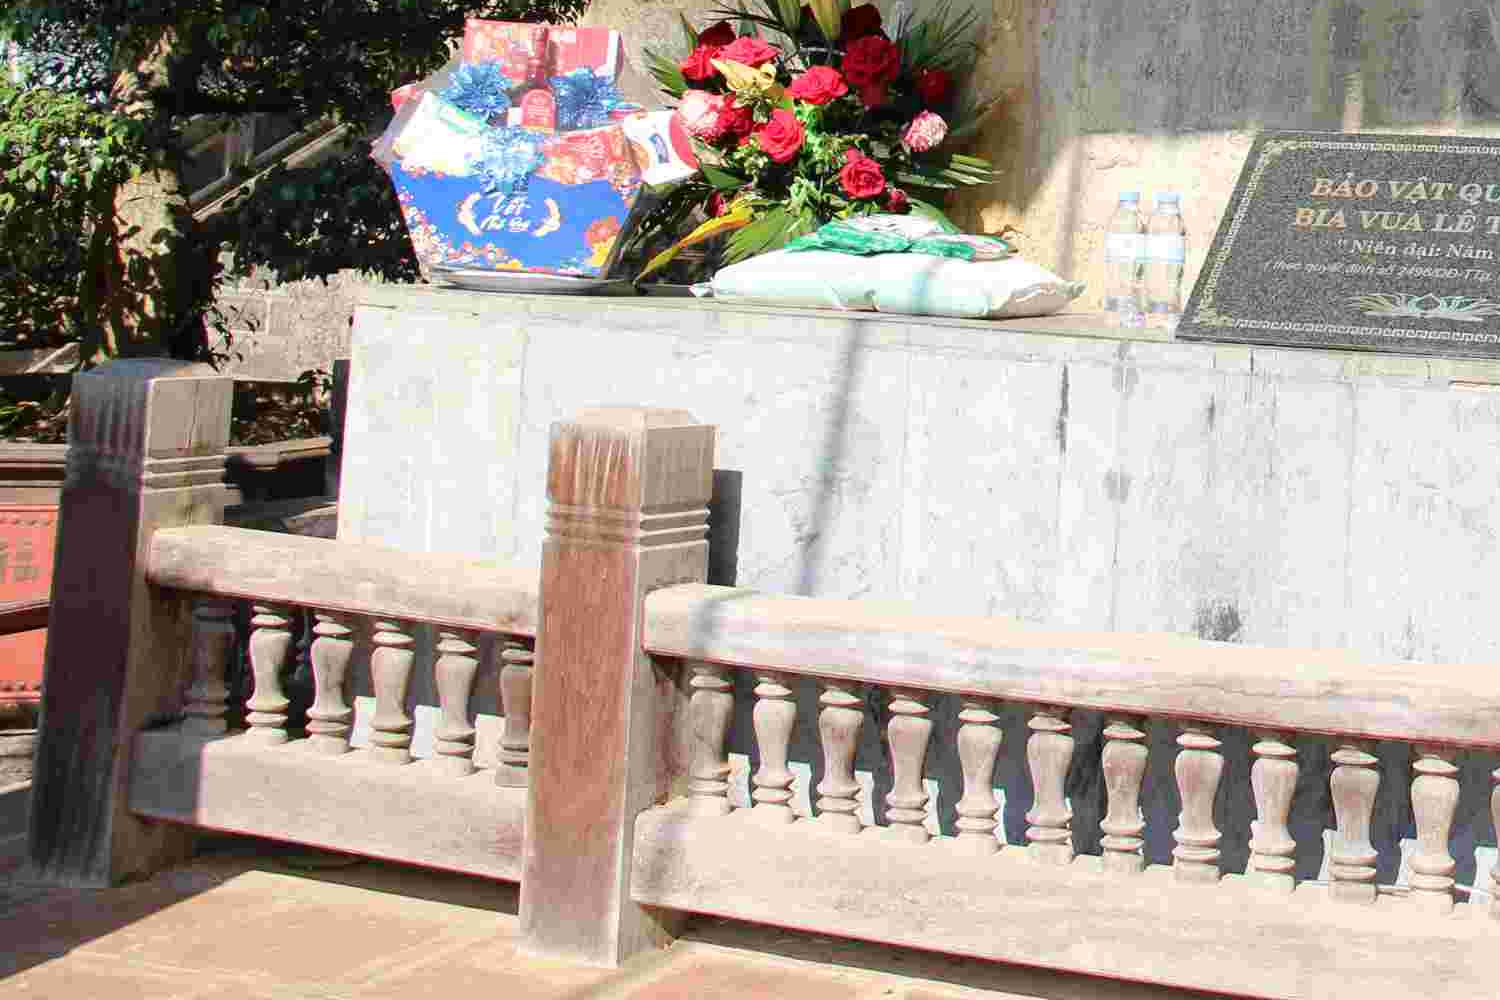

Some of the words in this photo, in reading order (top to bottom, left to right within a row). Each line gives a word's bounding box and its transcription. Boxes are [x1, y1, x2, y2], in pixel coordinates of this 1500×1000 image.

[1310, 171, 1378, 201] BẢO
[1388, 175, 1456, 204] VẬT
[1294, 206, 1347, 232] BIA
[1357, 209, 1425, 233] VUA
[1430, 208, 1477, 233] LÊ
[1446, 243, 1495, 261] Năm
